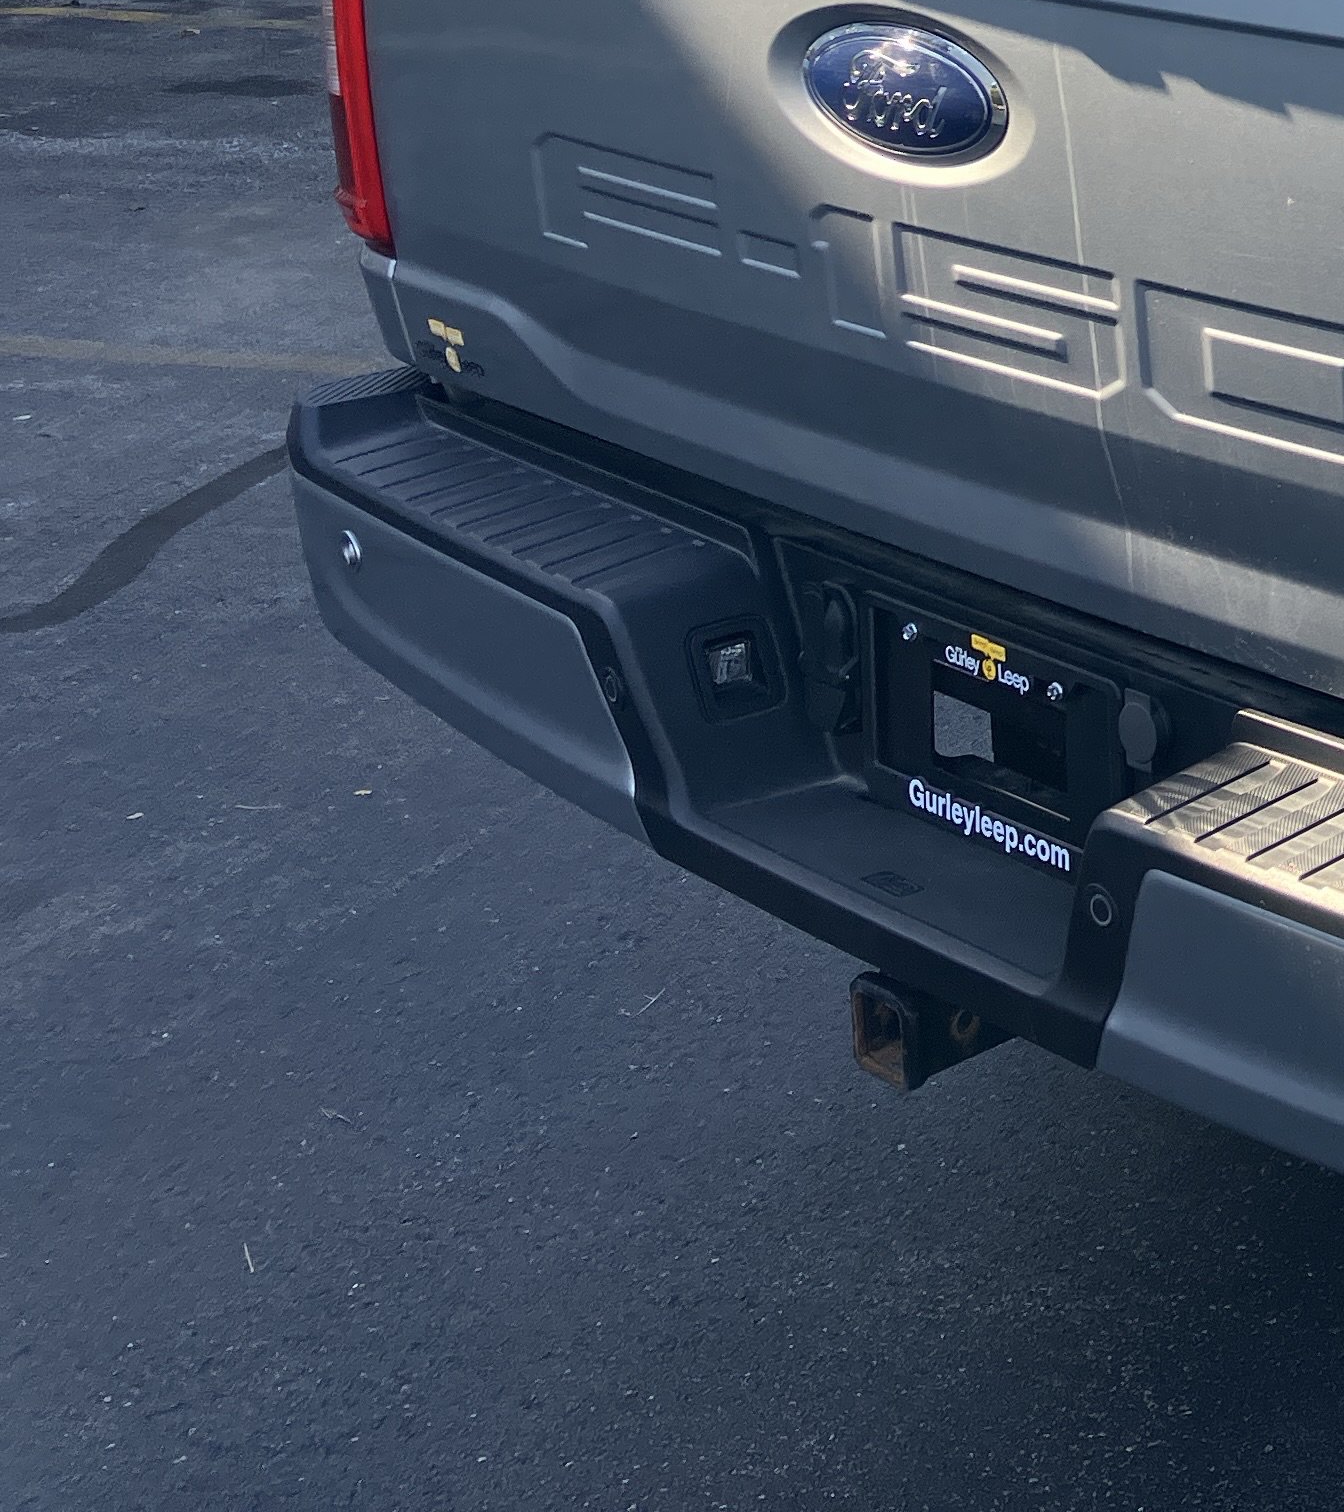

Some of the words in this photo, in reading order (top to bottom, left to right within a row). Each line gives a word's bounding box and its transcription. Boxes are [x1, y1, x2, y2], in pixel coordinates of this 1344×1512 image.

[843, 48, 948, 139] Ford
[997, 663, 1030, 695] Leep
[908, 778, 1071, 872] Gurleyleep.com
